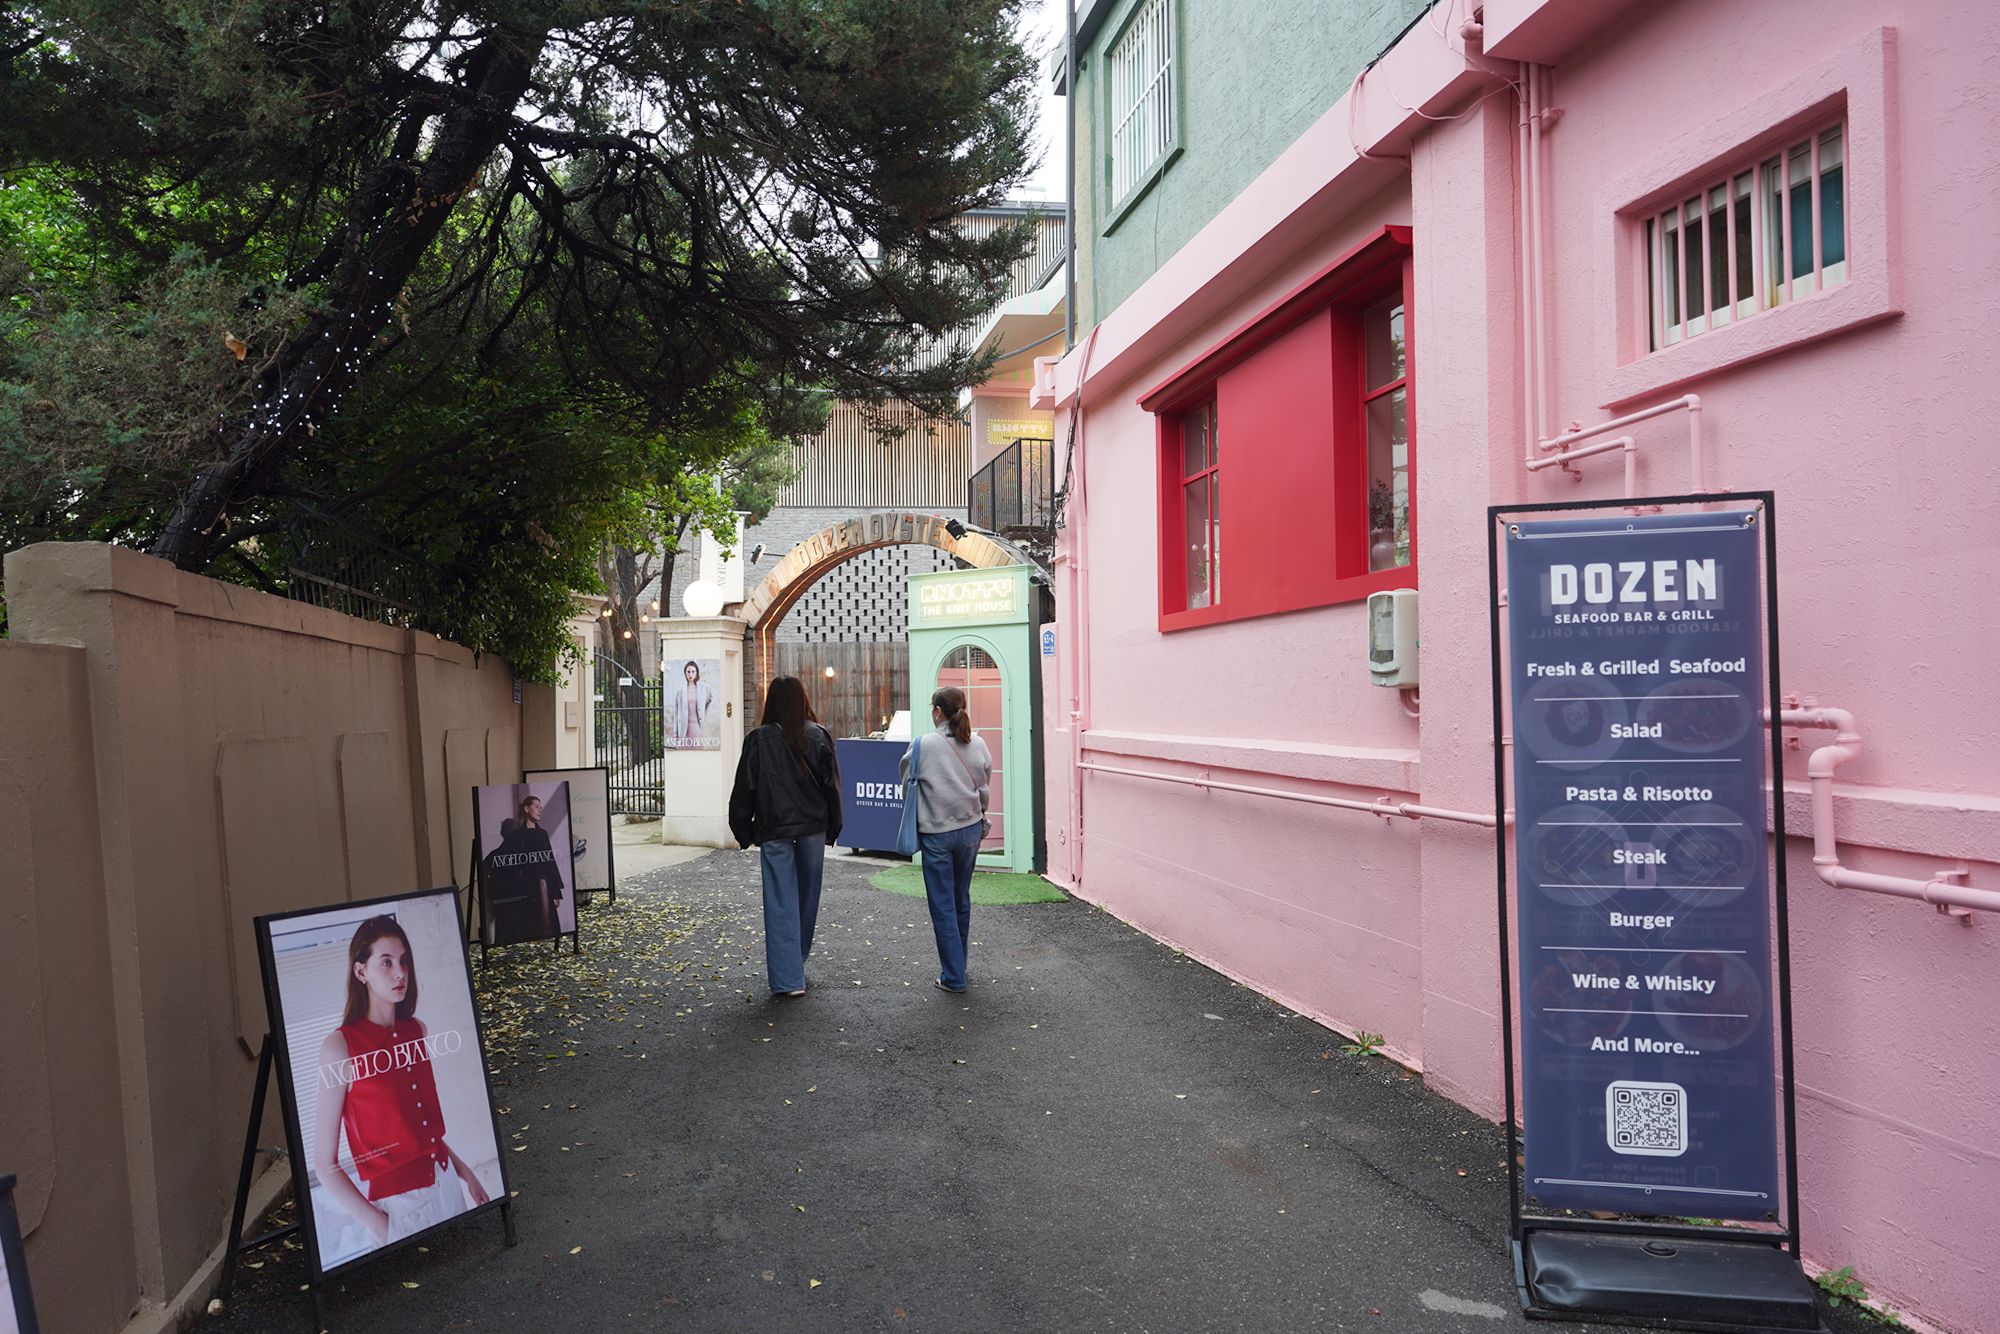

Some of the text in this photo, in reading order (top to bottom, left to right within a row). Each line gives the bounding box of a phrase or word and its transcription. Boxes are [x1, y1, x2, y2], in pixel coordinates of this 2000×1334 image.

[795, 517, 865, 572] DOZEN
[1550, 558, 1717, 605] DOZEN
[922, 600, 1012, 616] THE KNIT HOUSE
[1554, 609, 1714, 625] SEAFOOD BAR & GRILL
[1527, 657, 1746, 677] Fresh & Grilled Seafood
[1610, 722, 1663, 739] Salad
[856, 782, 904, 800] DOZEN
[1566, 786, 1713, 801] Pasta & Risotto
[491, 852, 528, 868] ANGELO
[1613, 849, 1667, 864] Steak
[1609, 912, 1675, 930] Burger
[1572, 973, 1716, 995] Wine & Whisky
[1591, 1036, 1700, 1056] And More...
[318, 1029, 462, 1090] ANGELO BIANCO
